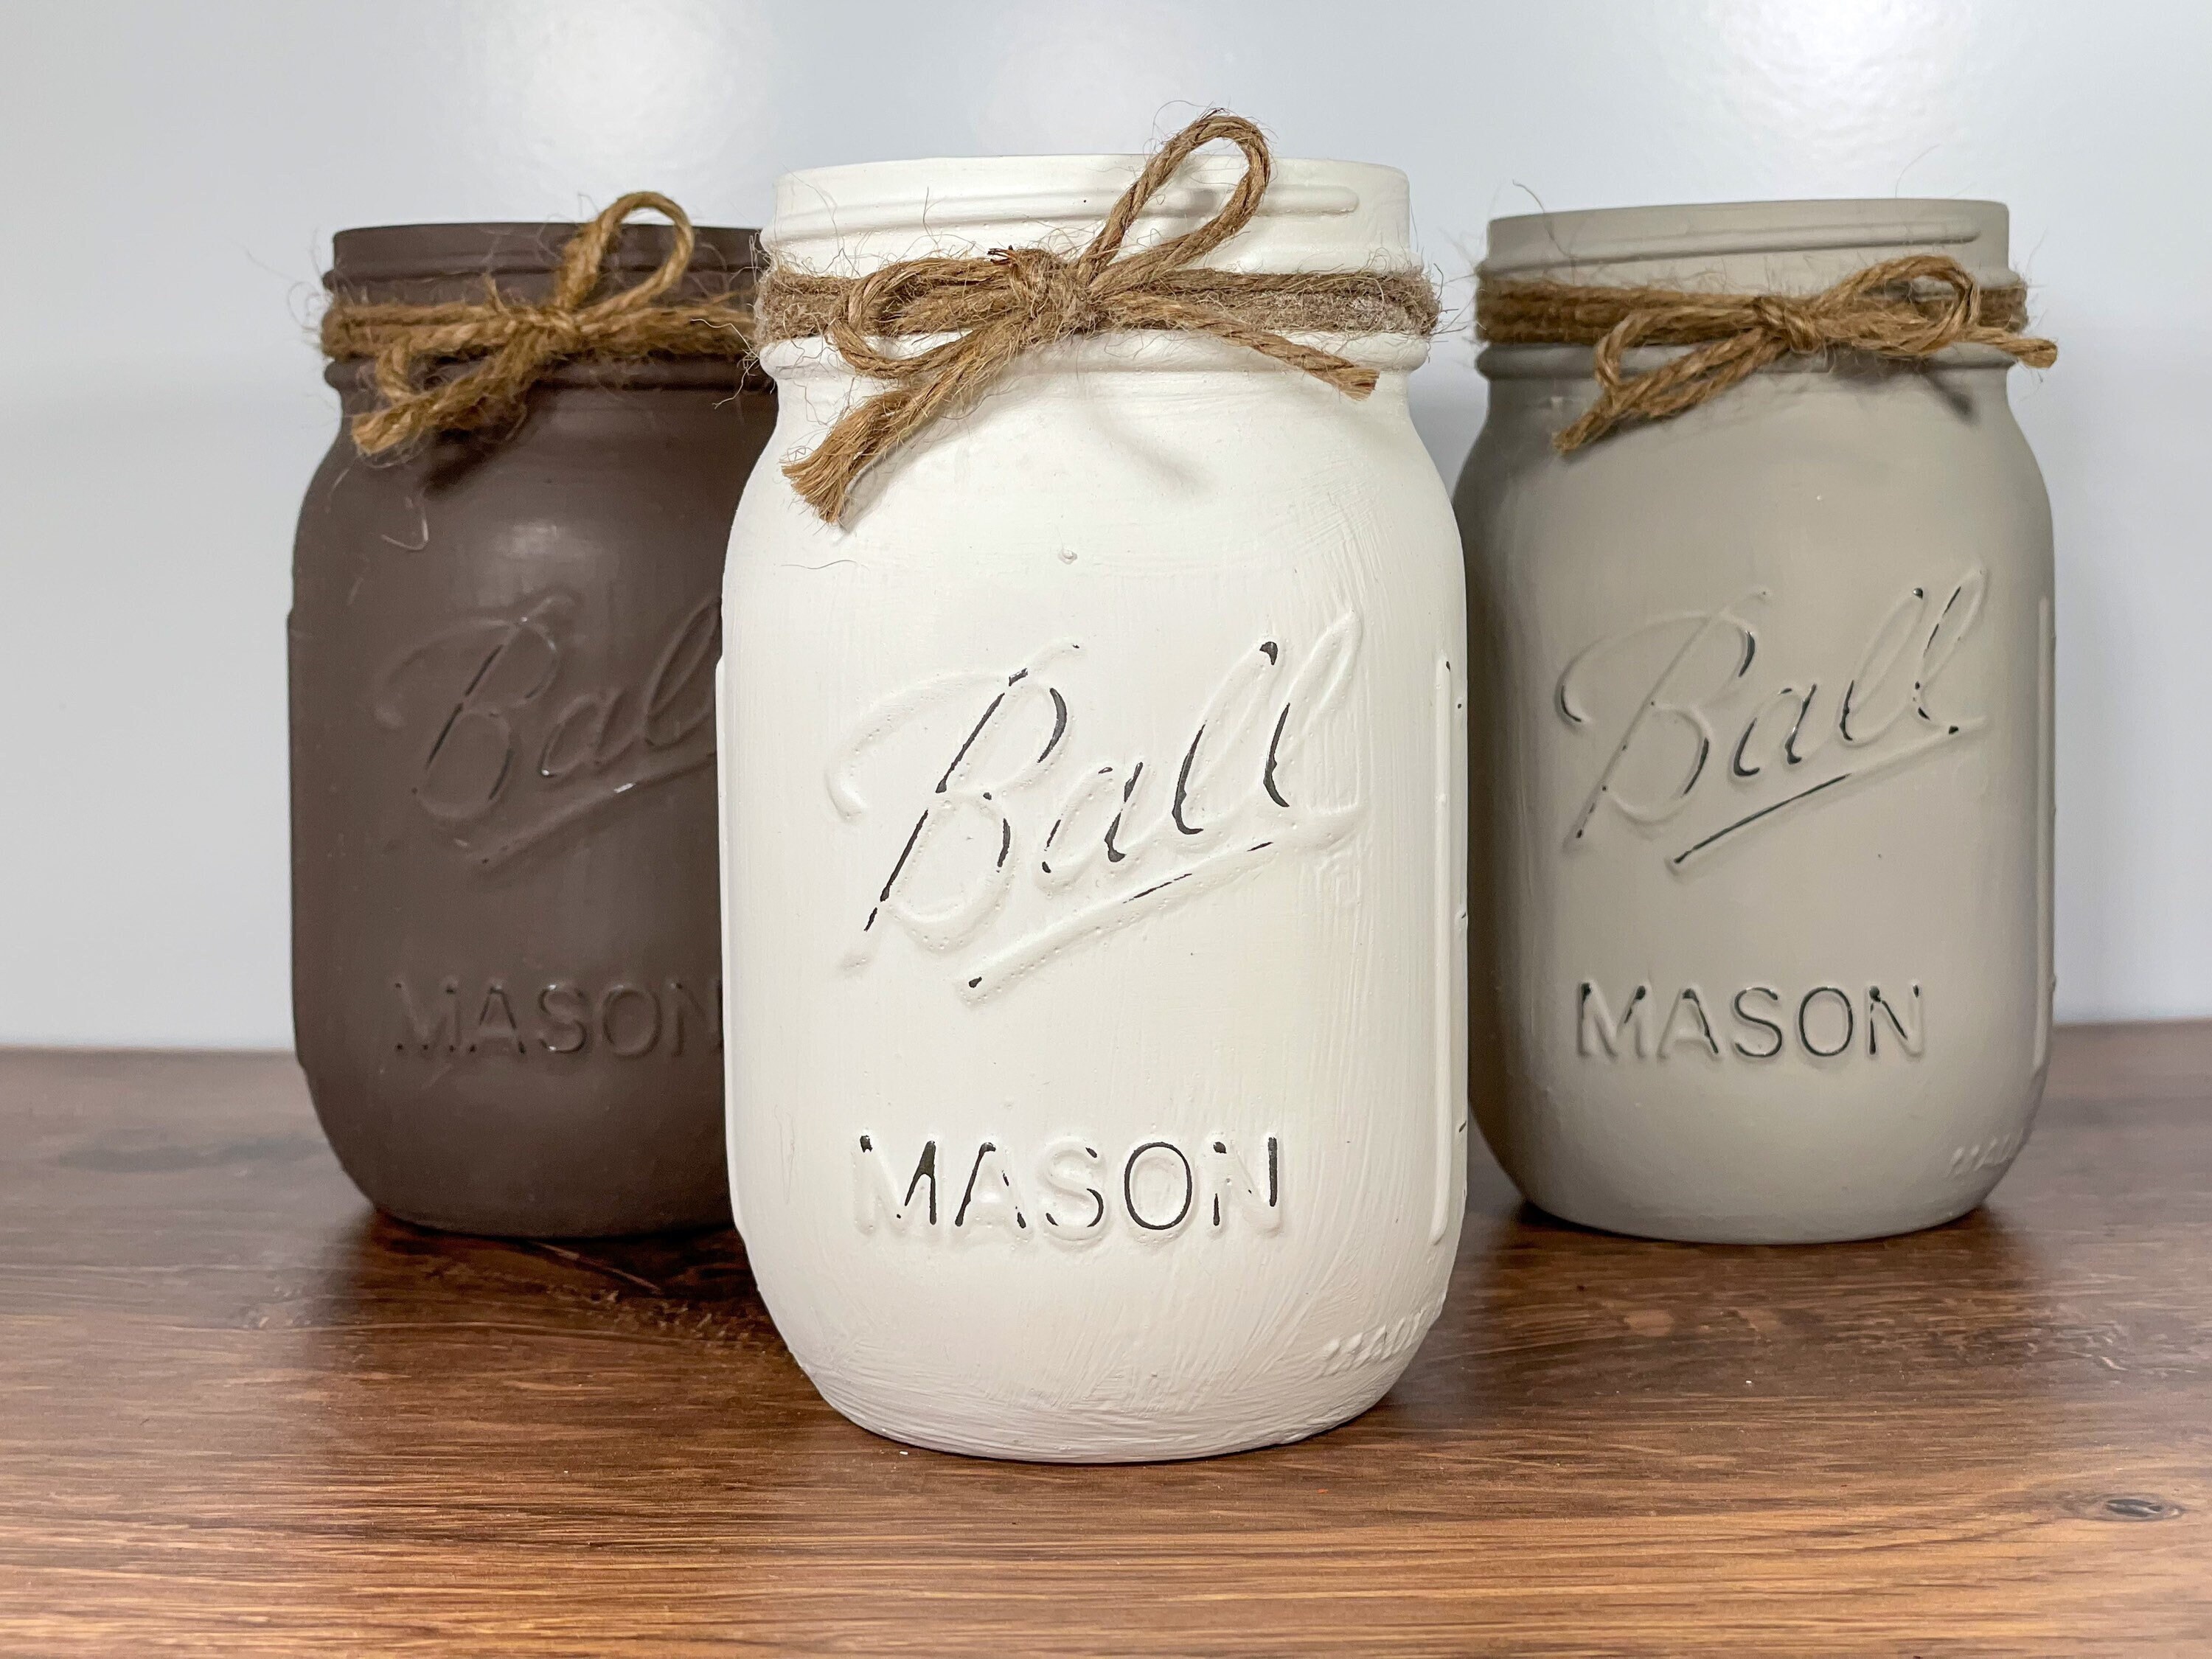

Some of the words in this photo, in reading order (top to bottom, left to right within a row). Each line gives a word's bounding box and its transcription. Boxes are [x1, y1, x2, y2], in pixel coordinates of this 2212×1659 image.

[372, 591, 720, 870] Bal
[824, 608, 1366, 1003] Ball
[1554, 566, 1989, 874] Ball
[389, 977, 723, 1054] MASON
[1576, 979, 1926, 1060] MASON
[855, 1132, 1284, 1245] MASON
